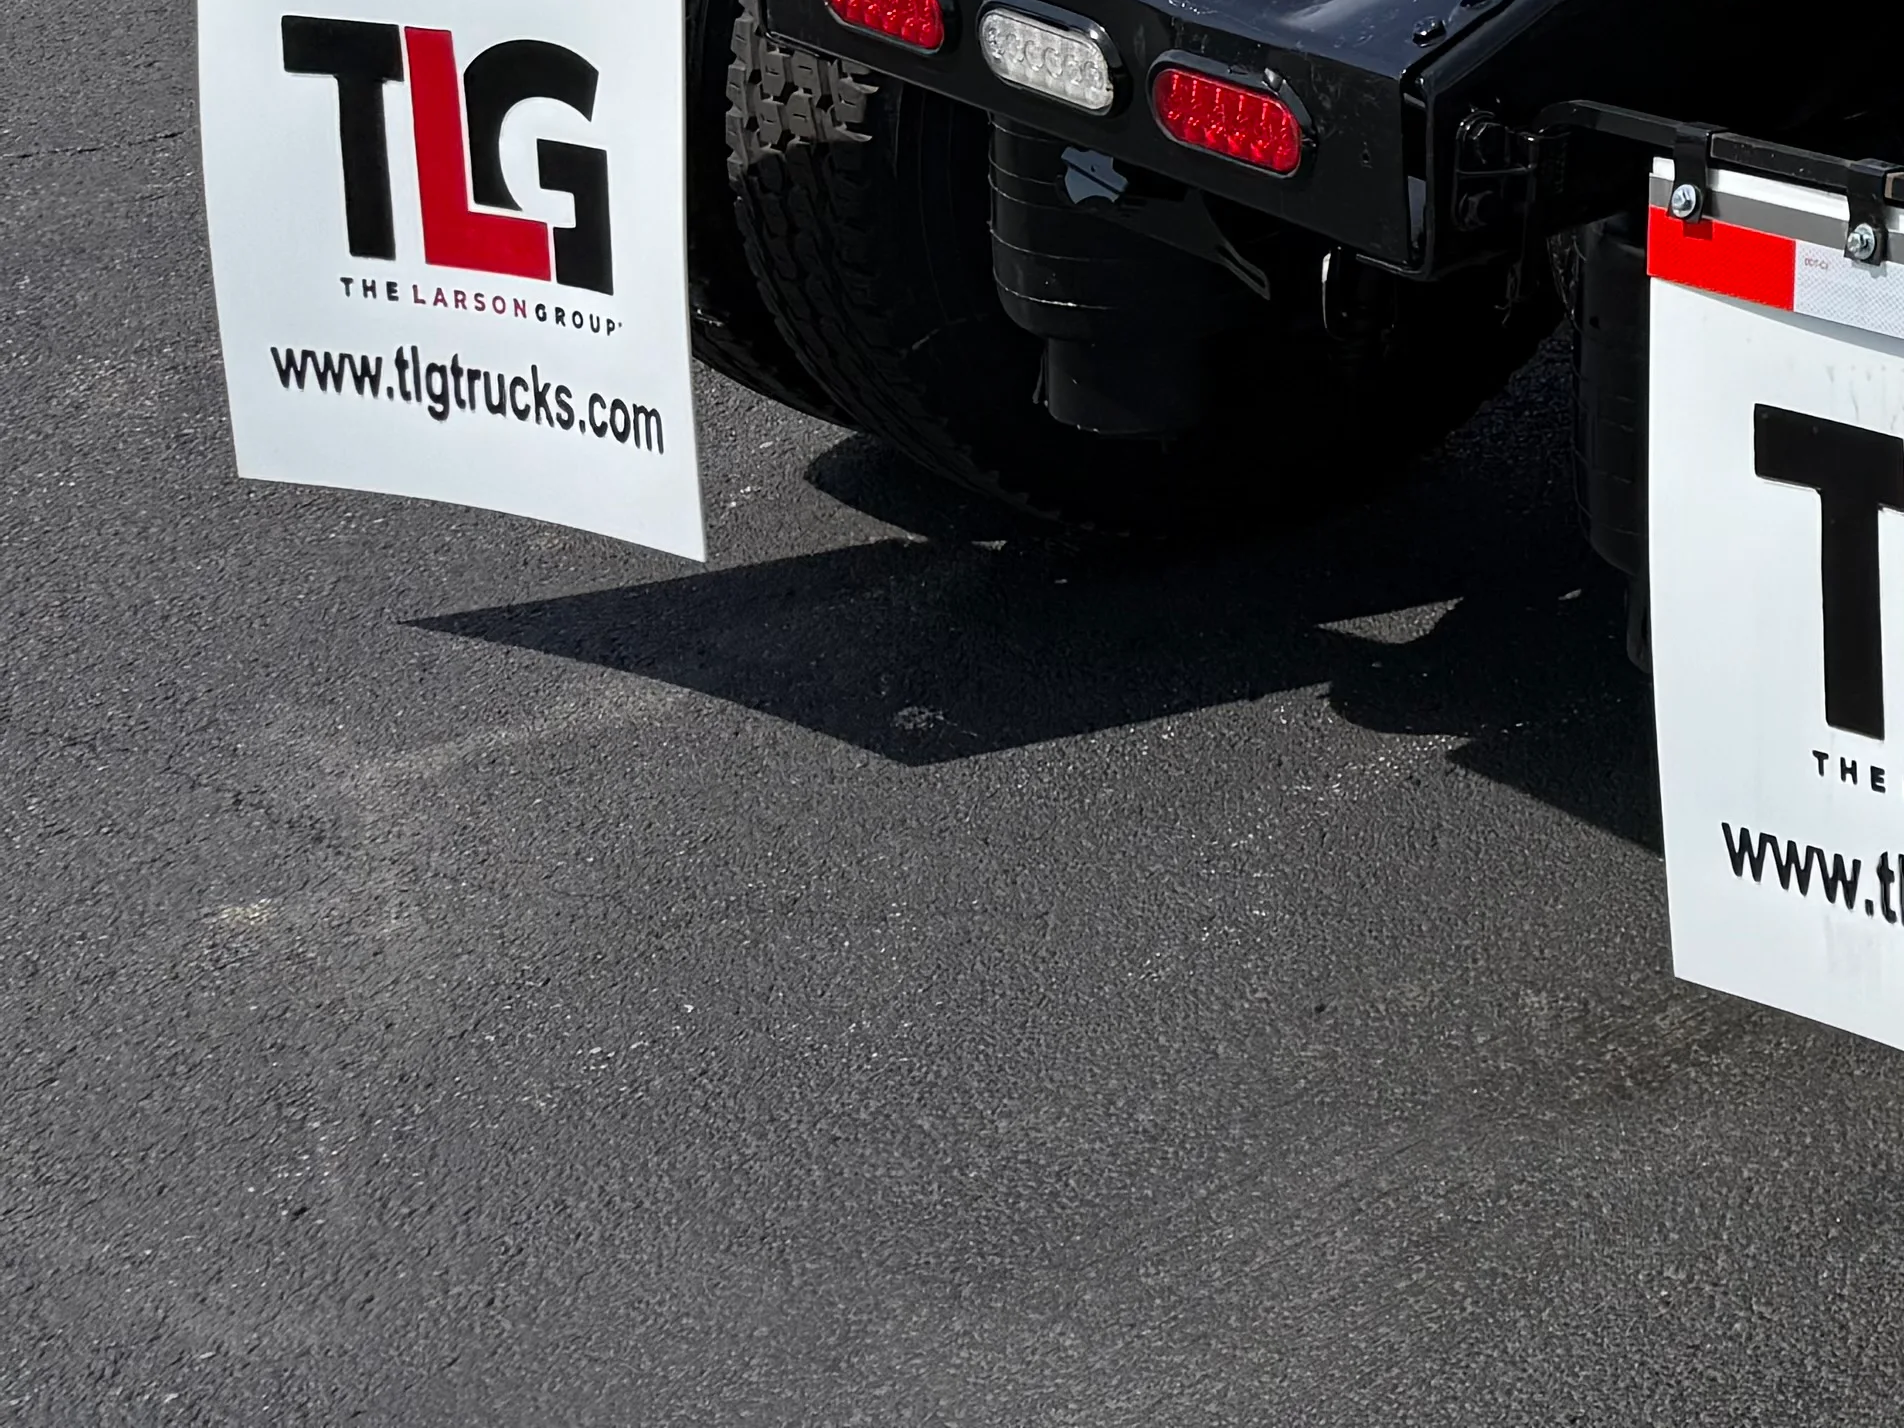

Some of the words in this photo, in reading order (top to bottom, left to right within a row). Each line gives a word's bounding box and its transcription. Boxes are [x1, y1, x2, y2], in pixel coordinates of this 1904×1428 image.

[281, 14, 614, 296] TLG
[340, 276, 400, 303] THE
[412, 284, 528, 319] LARSON
[534, 303, 618, 334] GROUP
[270, 344, 665, 455] www.tlgtrucks.com
[1812, 749, 1888, 793] THE
